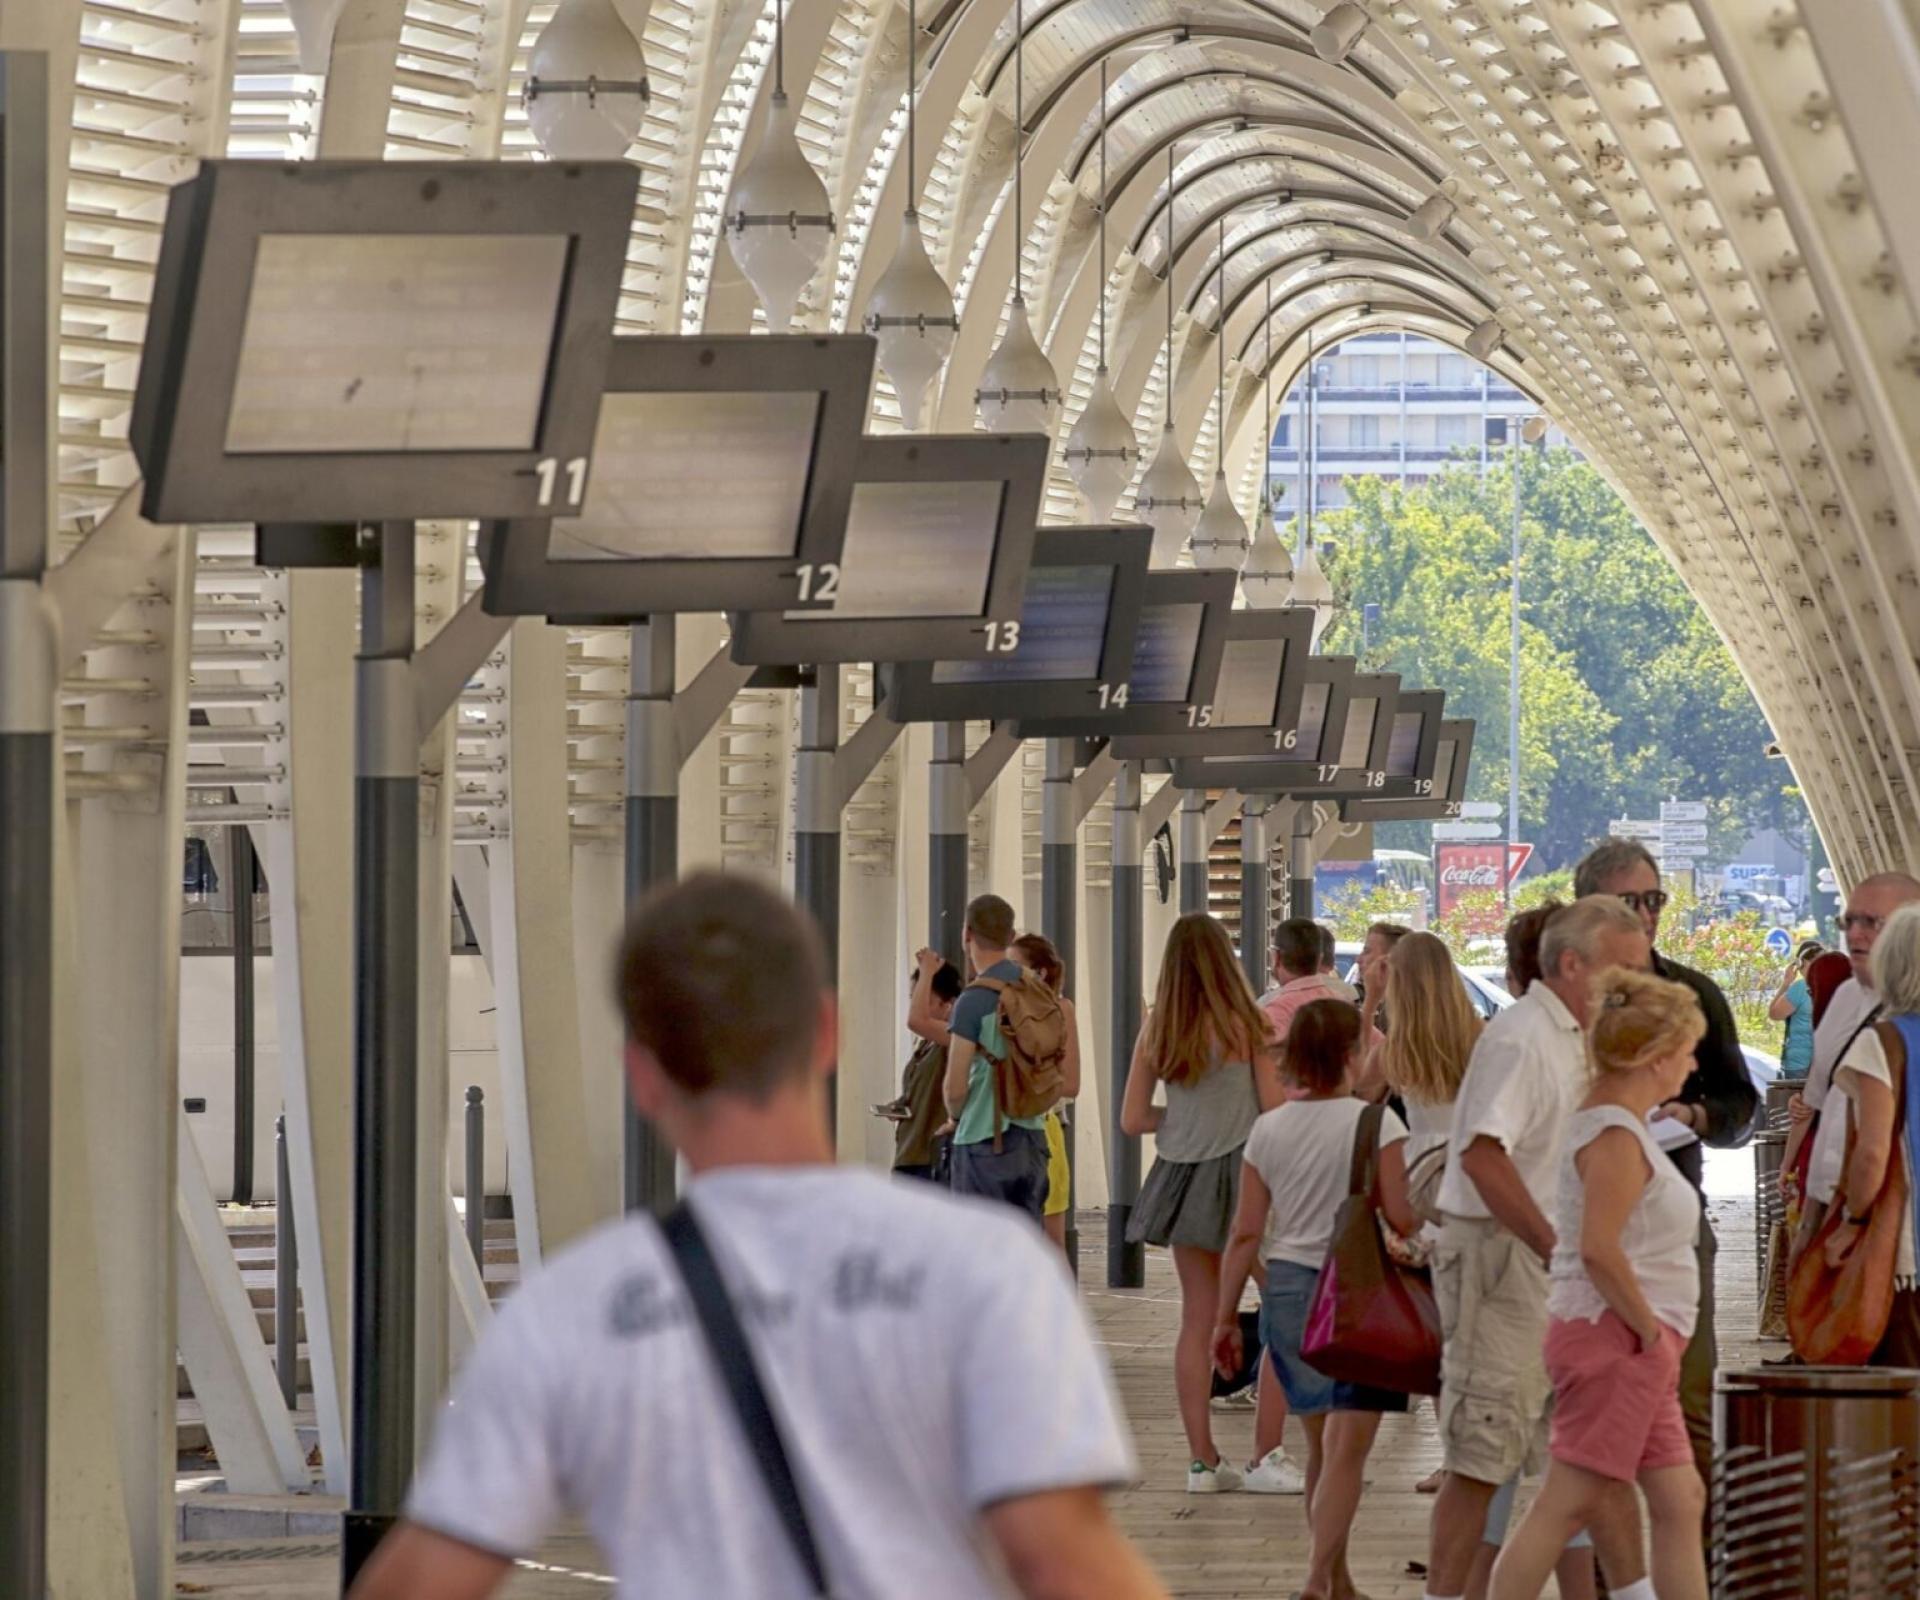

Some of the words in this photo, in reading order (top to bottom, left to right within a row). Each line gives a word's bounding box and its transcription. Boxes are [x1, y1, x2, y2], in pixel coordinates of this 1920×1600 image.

[536, 457, 588, 507] 11
[796, 564, 839, 601] 12
[983, 621, 1020, 651] 13
[1097, 683, 1128, 709] 14
[1187, 705, 1212, 727] 15
[1273, 730, 1297, 749] 16
[1317, 765, 1340, 782] 17
[1366, 771, 1386, 787] 18
[1414, 779, 1433, 793] 19
[1445, 801, 1463, 815] 20
